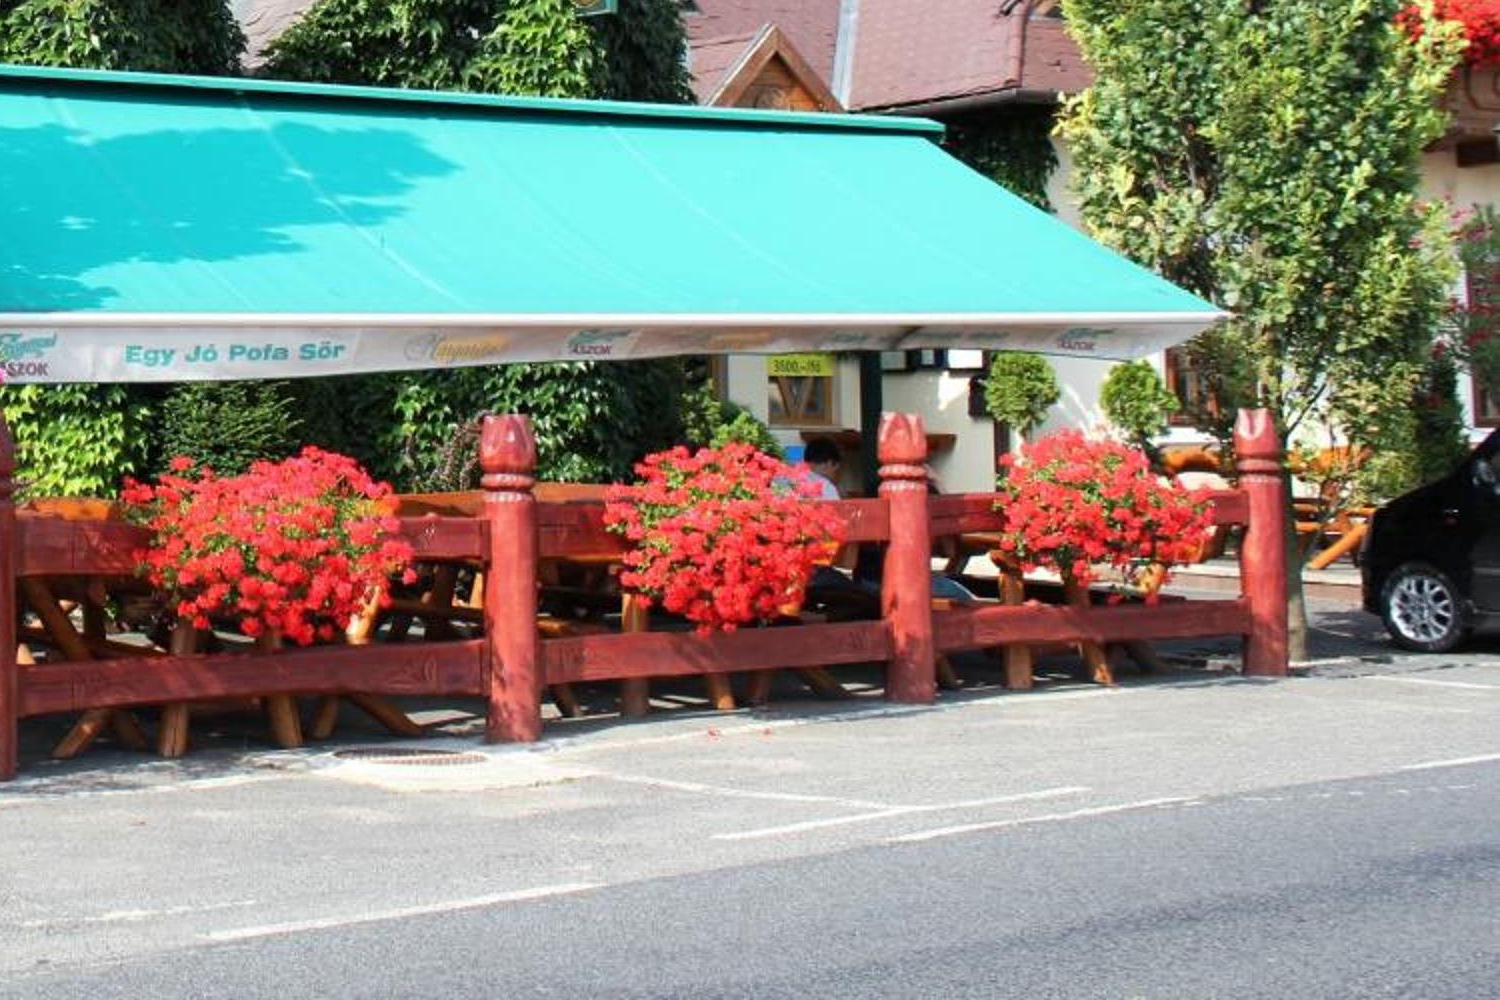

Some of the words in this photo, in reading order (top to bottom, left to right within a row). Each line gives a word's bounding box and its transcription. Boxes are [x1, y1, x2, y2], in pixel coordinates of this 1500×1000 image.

[125, 344, 175, 367] Egy
[185, 343, 218, 363] Jó
[229, 343, 290, 361] Pofa
[299, 340, 346, 361] Sör
